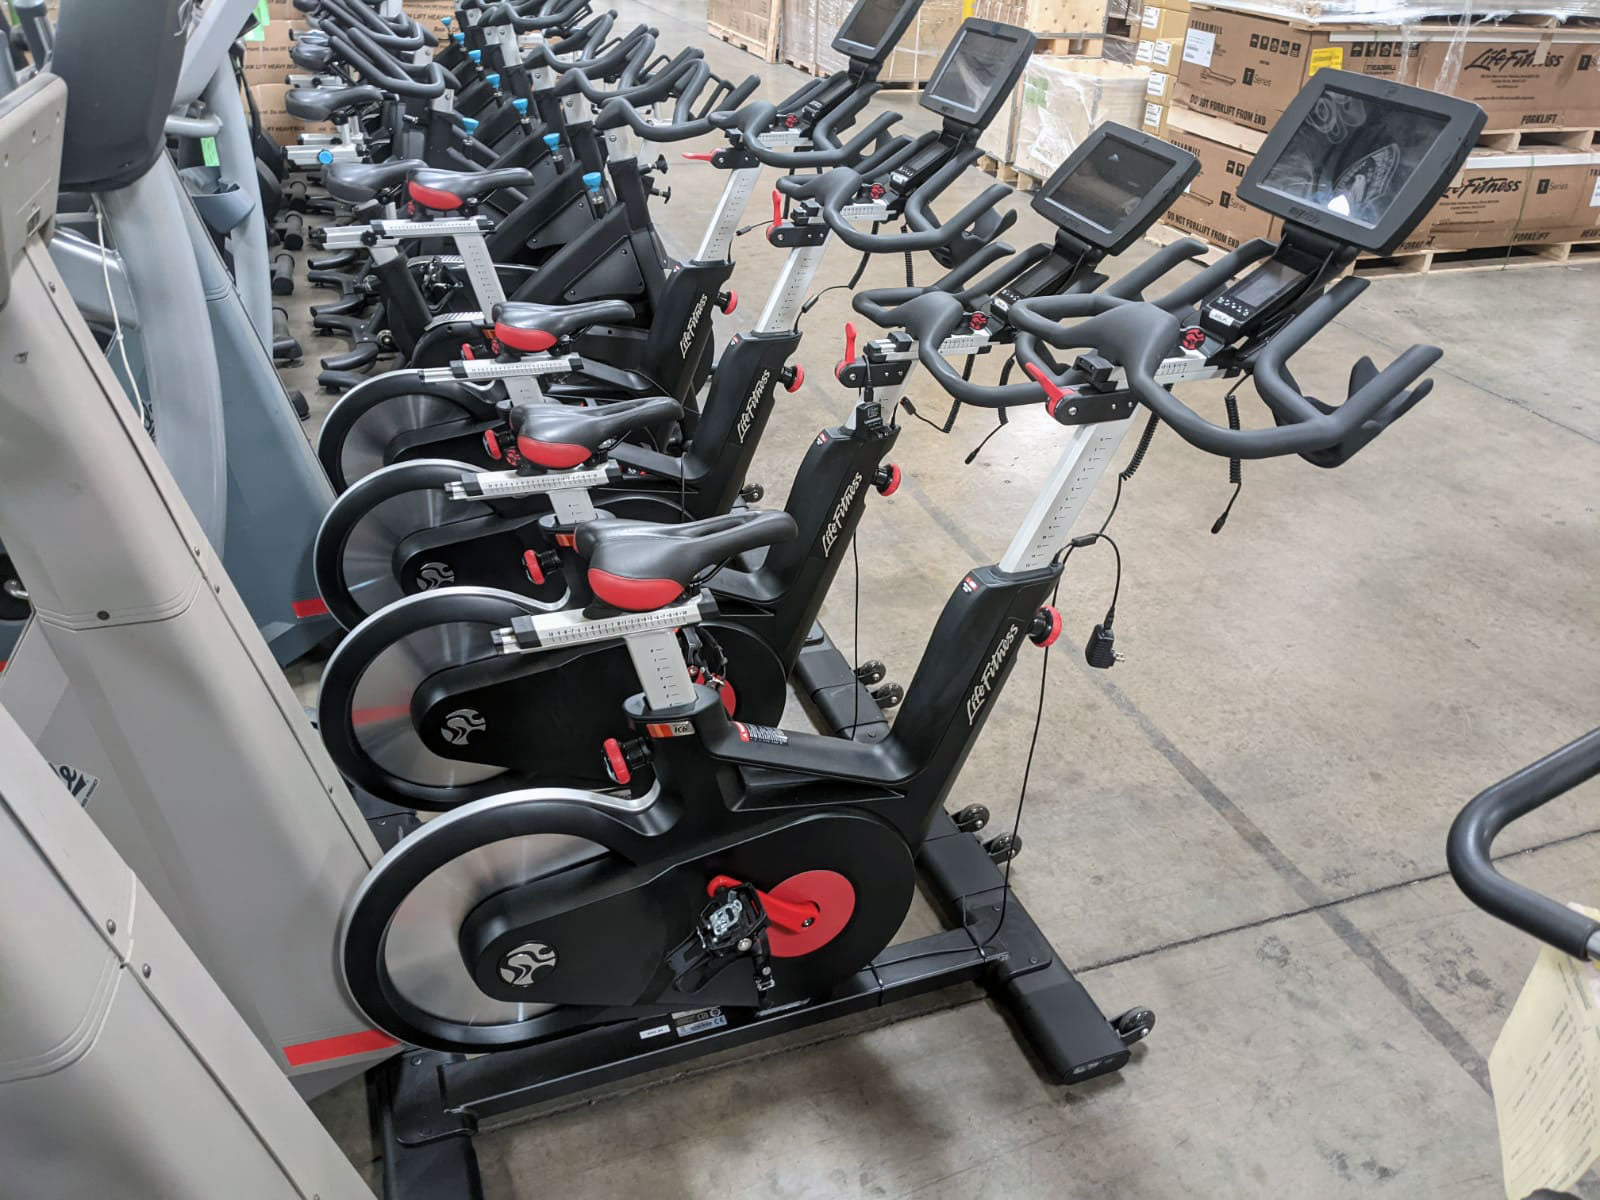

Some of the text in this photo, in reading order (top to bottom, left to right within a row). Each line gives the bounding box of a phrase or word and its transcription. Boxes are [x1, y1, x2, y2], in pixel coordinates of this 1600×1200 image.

[1210, 100, 1236, 117] FORKLIFT
[1236, 108, 1254, 122] FROM
[1254, 113, 1267, 126] END
[1521, 113, 1558, 125] FORKLIFT
[1167, 211, 1240, 249] DO NOT FORKLIFT FROM END
[1513, 231, 1551, 242] FORKLIFT
